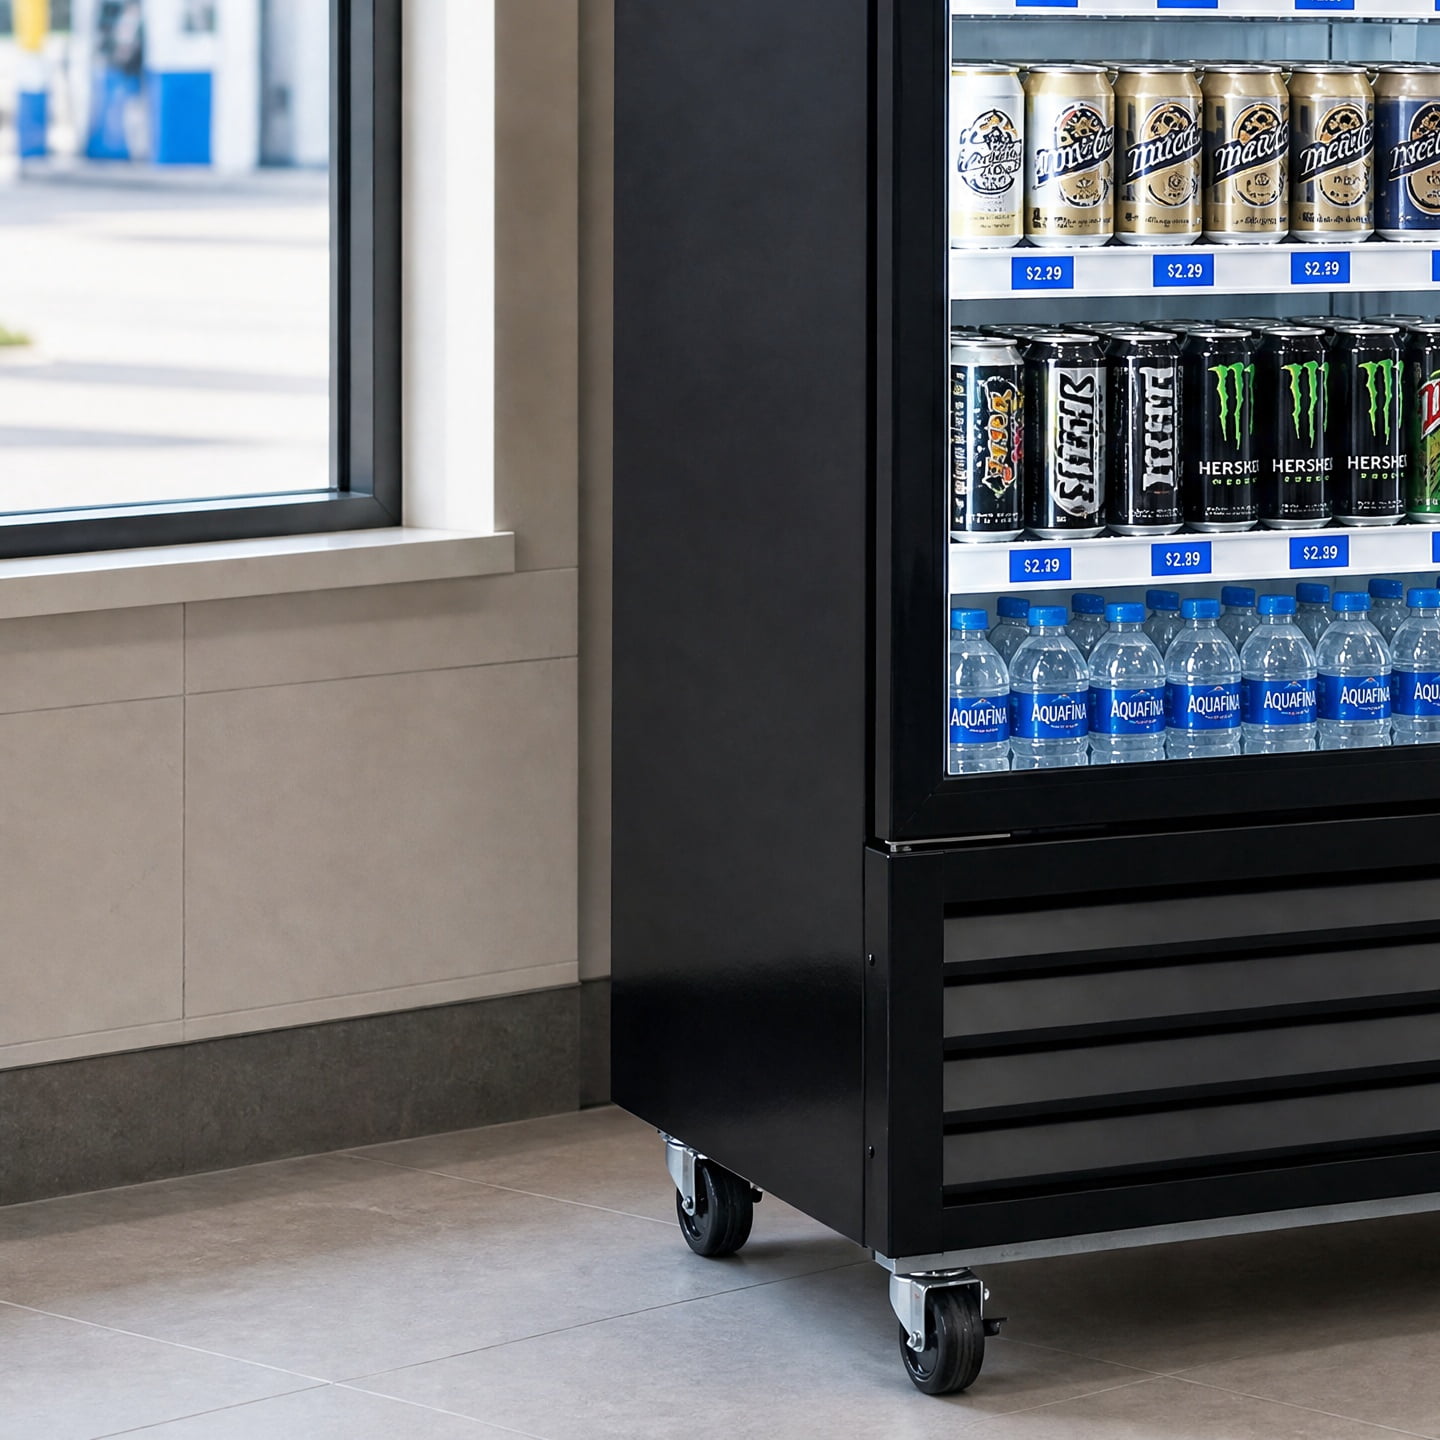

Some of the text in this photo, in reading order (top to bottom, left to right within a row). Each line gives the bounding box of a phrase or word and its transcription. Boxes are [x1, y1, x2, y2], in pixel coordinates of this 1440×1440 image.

[1167, 263, 1203, 279] $2.29
[1187, 691, 1241, 715] AQUAFINA
[1264, 687, 1317, 710] AQUAFINA
[1340, 682, 1391, 704] AQUAFINA
[951, 705, 1007, 727] AQUAFINA
[1031, 700, 1087, 722] AQUAFINA
[1110, 695, 1164, 719] AQUAFINA
